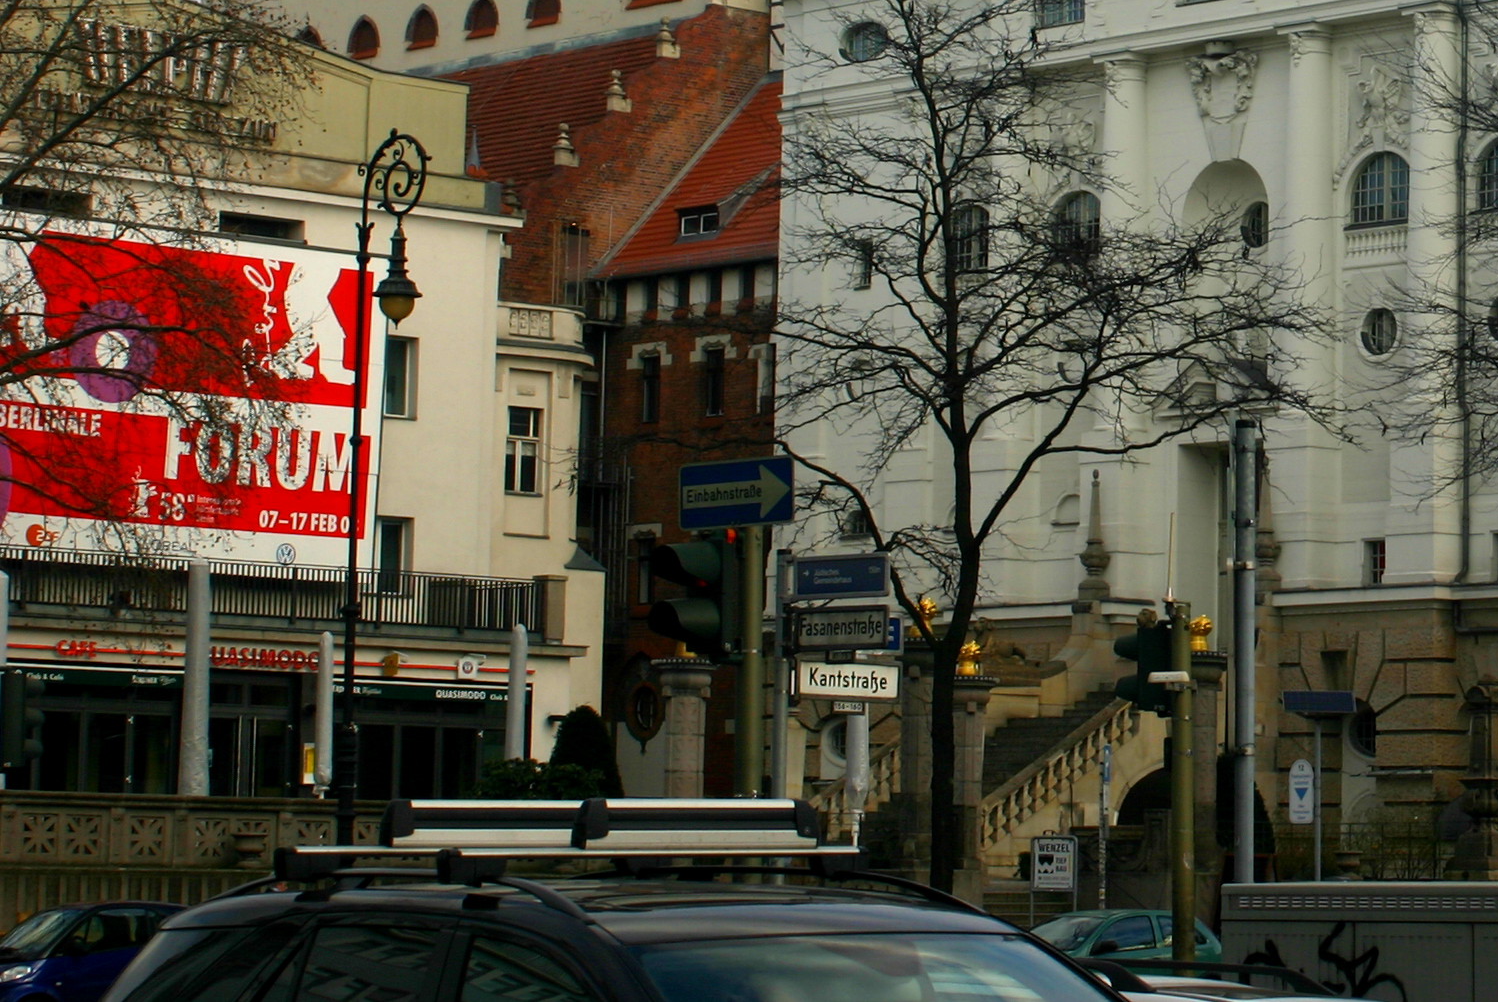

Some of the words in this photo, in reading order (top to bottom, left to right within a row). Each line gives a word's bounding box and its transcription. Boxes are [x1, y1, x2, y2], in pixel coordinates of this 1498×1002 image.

[163, 414, 352, 495] FORUM
[686, 484, 763, 504] Einbahnstraße
[310, 513, 337, 533] FEB
[799, 614, 882, 639] Fasanenstraße
[210, 646, 320, 671] UASIMODO
[809, 666, 888, 694] Kantstraße
[435, 690, 487, 701] QUASIMODO
